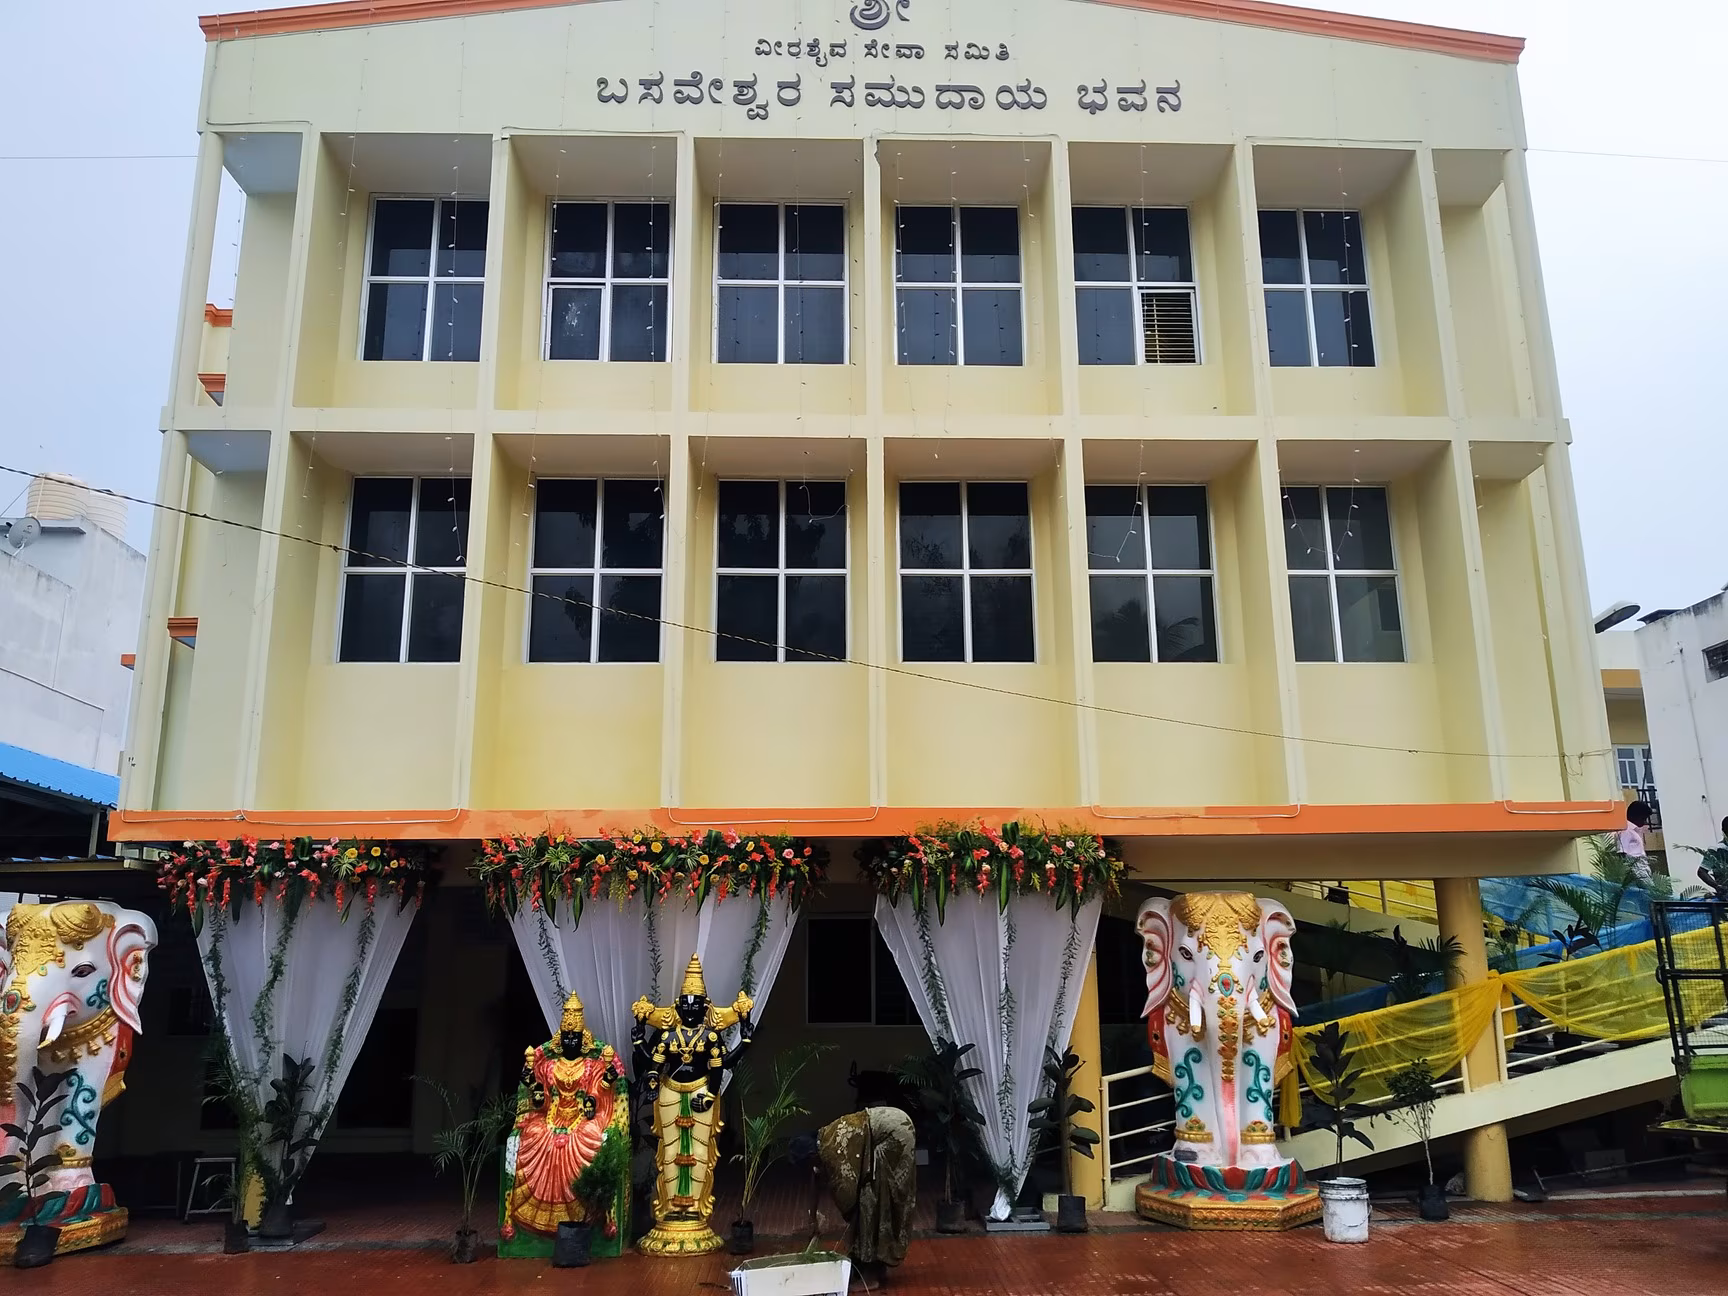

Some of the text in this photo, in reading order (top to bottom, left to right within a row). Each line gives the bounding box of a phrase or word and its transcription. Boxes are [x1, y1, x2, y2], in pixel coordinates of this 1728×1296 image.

[754, 38, 1010, 67] ವೀರಶೈವ ಸೇವಾ ಸಮಿತಿ
[596, 71, 1182, 121] ಬಸವೇಶ್ವರ ಸಮುದಾಯ ಭವನ
